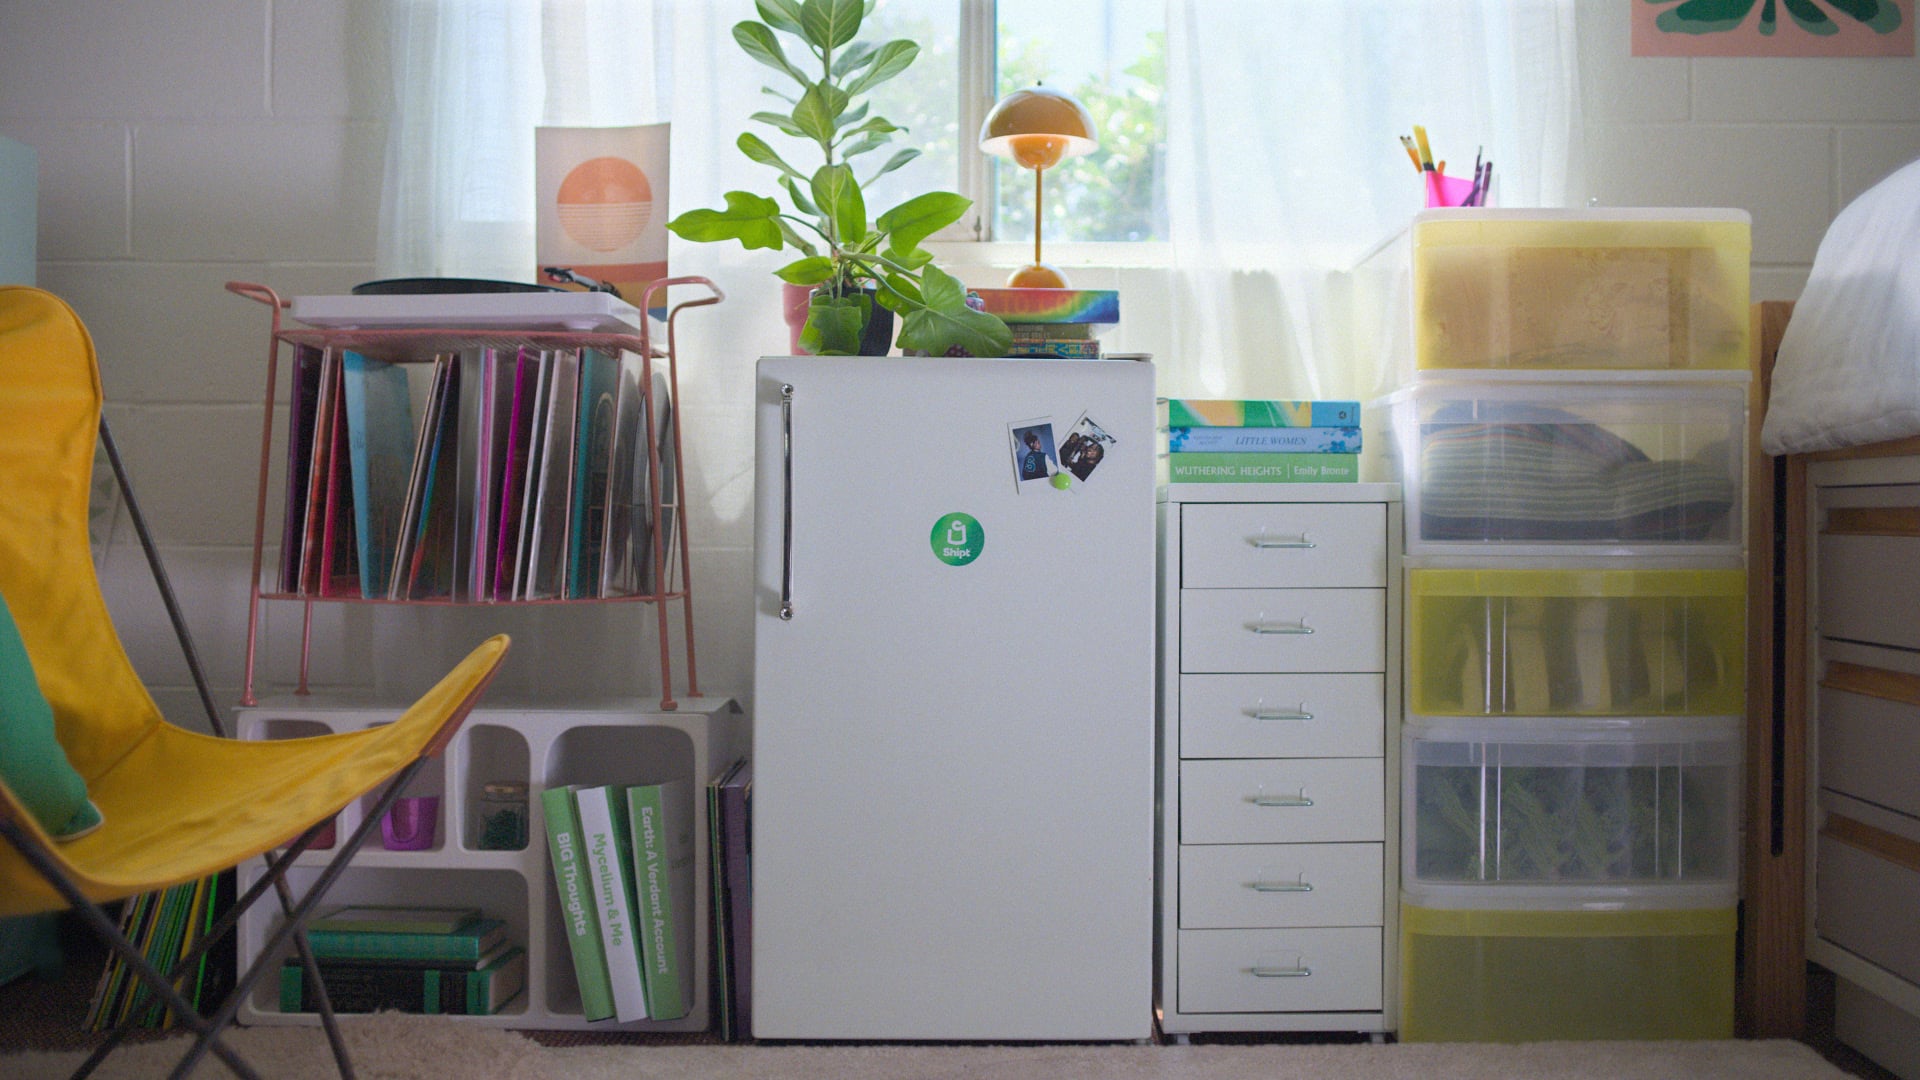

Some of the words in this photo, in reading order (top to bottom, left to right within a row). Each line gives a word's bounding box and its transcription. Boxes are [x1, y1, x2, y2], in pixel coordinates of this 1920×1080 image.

[1235, 437, 1267, 446] LITTLE
[1270, 437, 1306, 446] WOMEN
[1175, 466, 1236, 476] WUTHERING
[1240, 466, 1282, 476] HEIGHTS
[1294, 466, 1318, 476] Emily
[943, 547, 971, 559] Shipt
[641, 806, 655, 849] Earth:
[557, 832, 573, 861] BIG
[646, 850, 658, 862] A
[593, 833, 614, 907] Mycelium
[563, 862, 586, 937] Thoughts
[647, 863, 663, 917] Verdant
[607, 908, 618, 920] &
[611, 921, 623, 947] Me
[653, 918, 668, 974] Account
